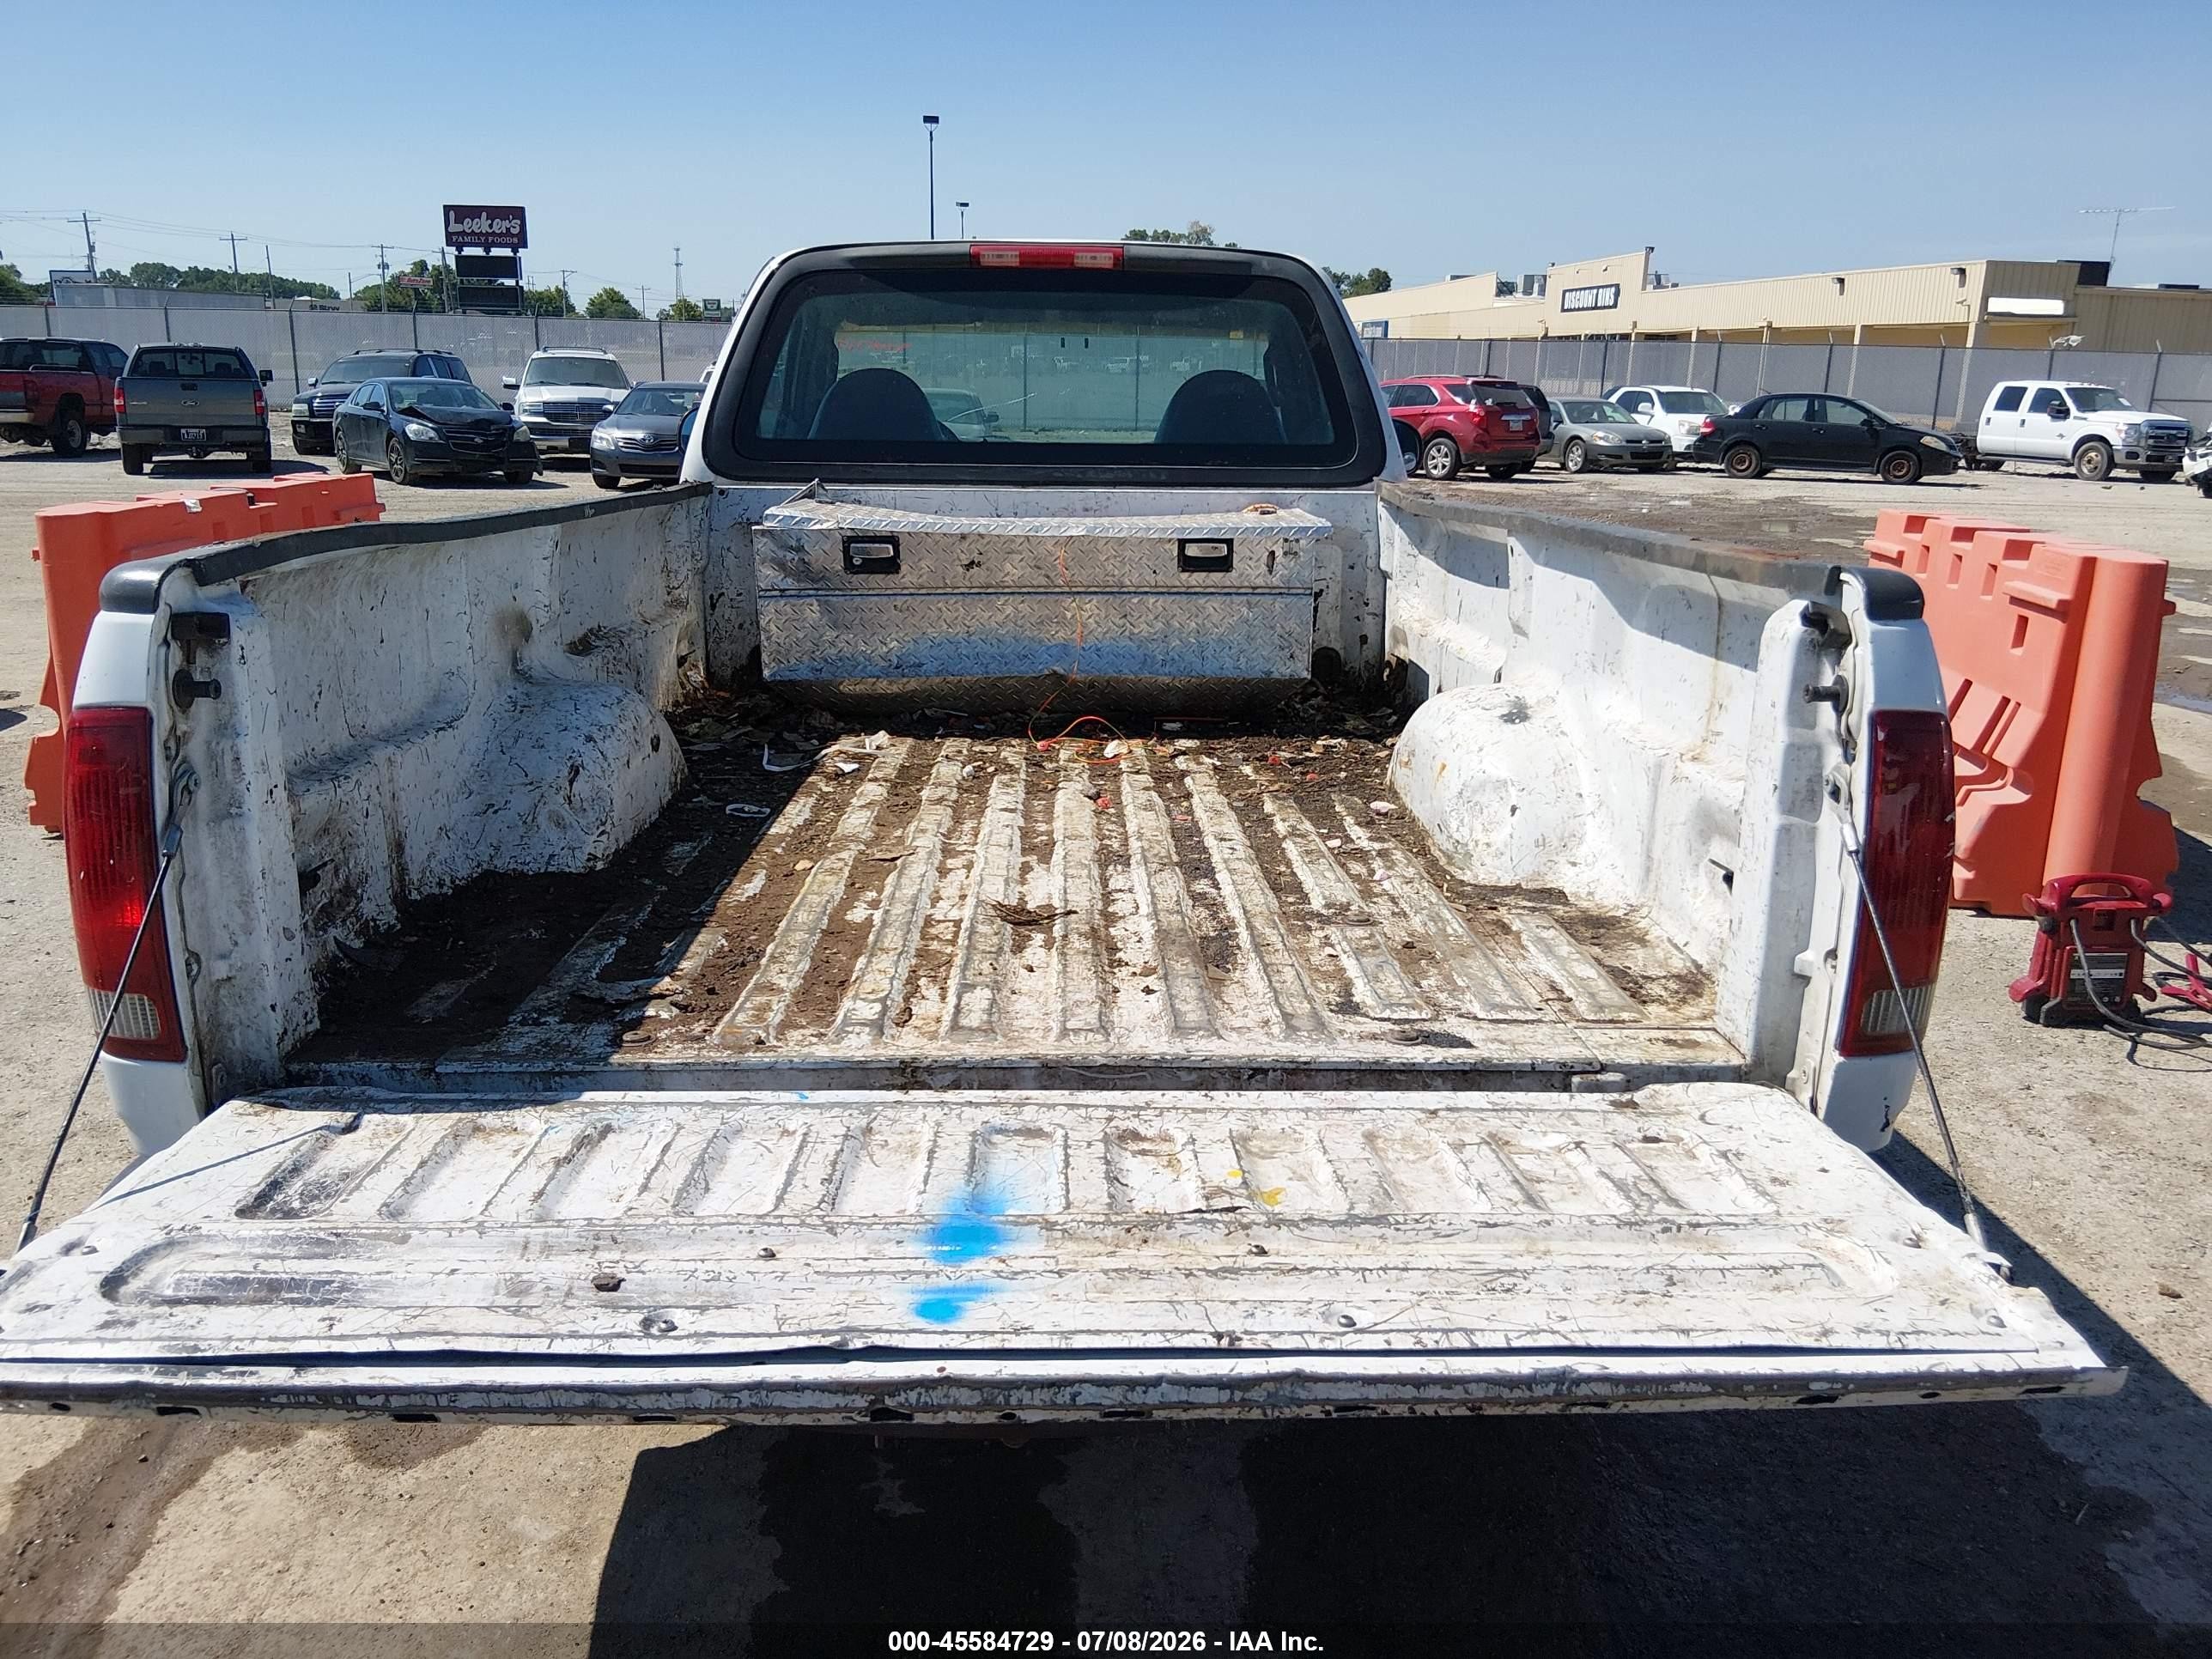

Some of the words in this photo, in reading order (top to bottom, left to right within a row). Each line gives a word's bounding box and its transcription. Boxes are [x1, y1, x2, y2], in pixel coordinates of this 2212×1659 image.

[447, 210, 520, 234] Leeker's
[1564, 289, 1598, 309] DISCOUNT
[1597, 287, 1615, 307] BINS
